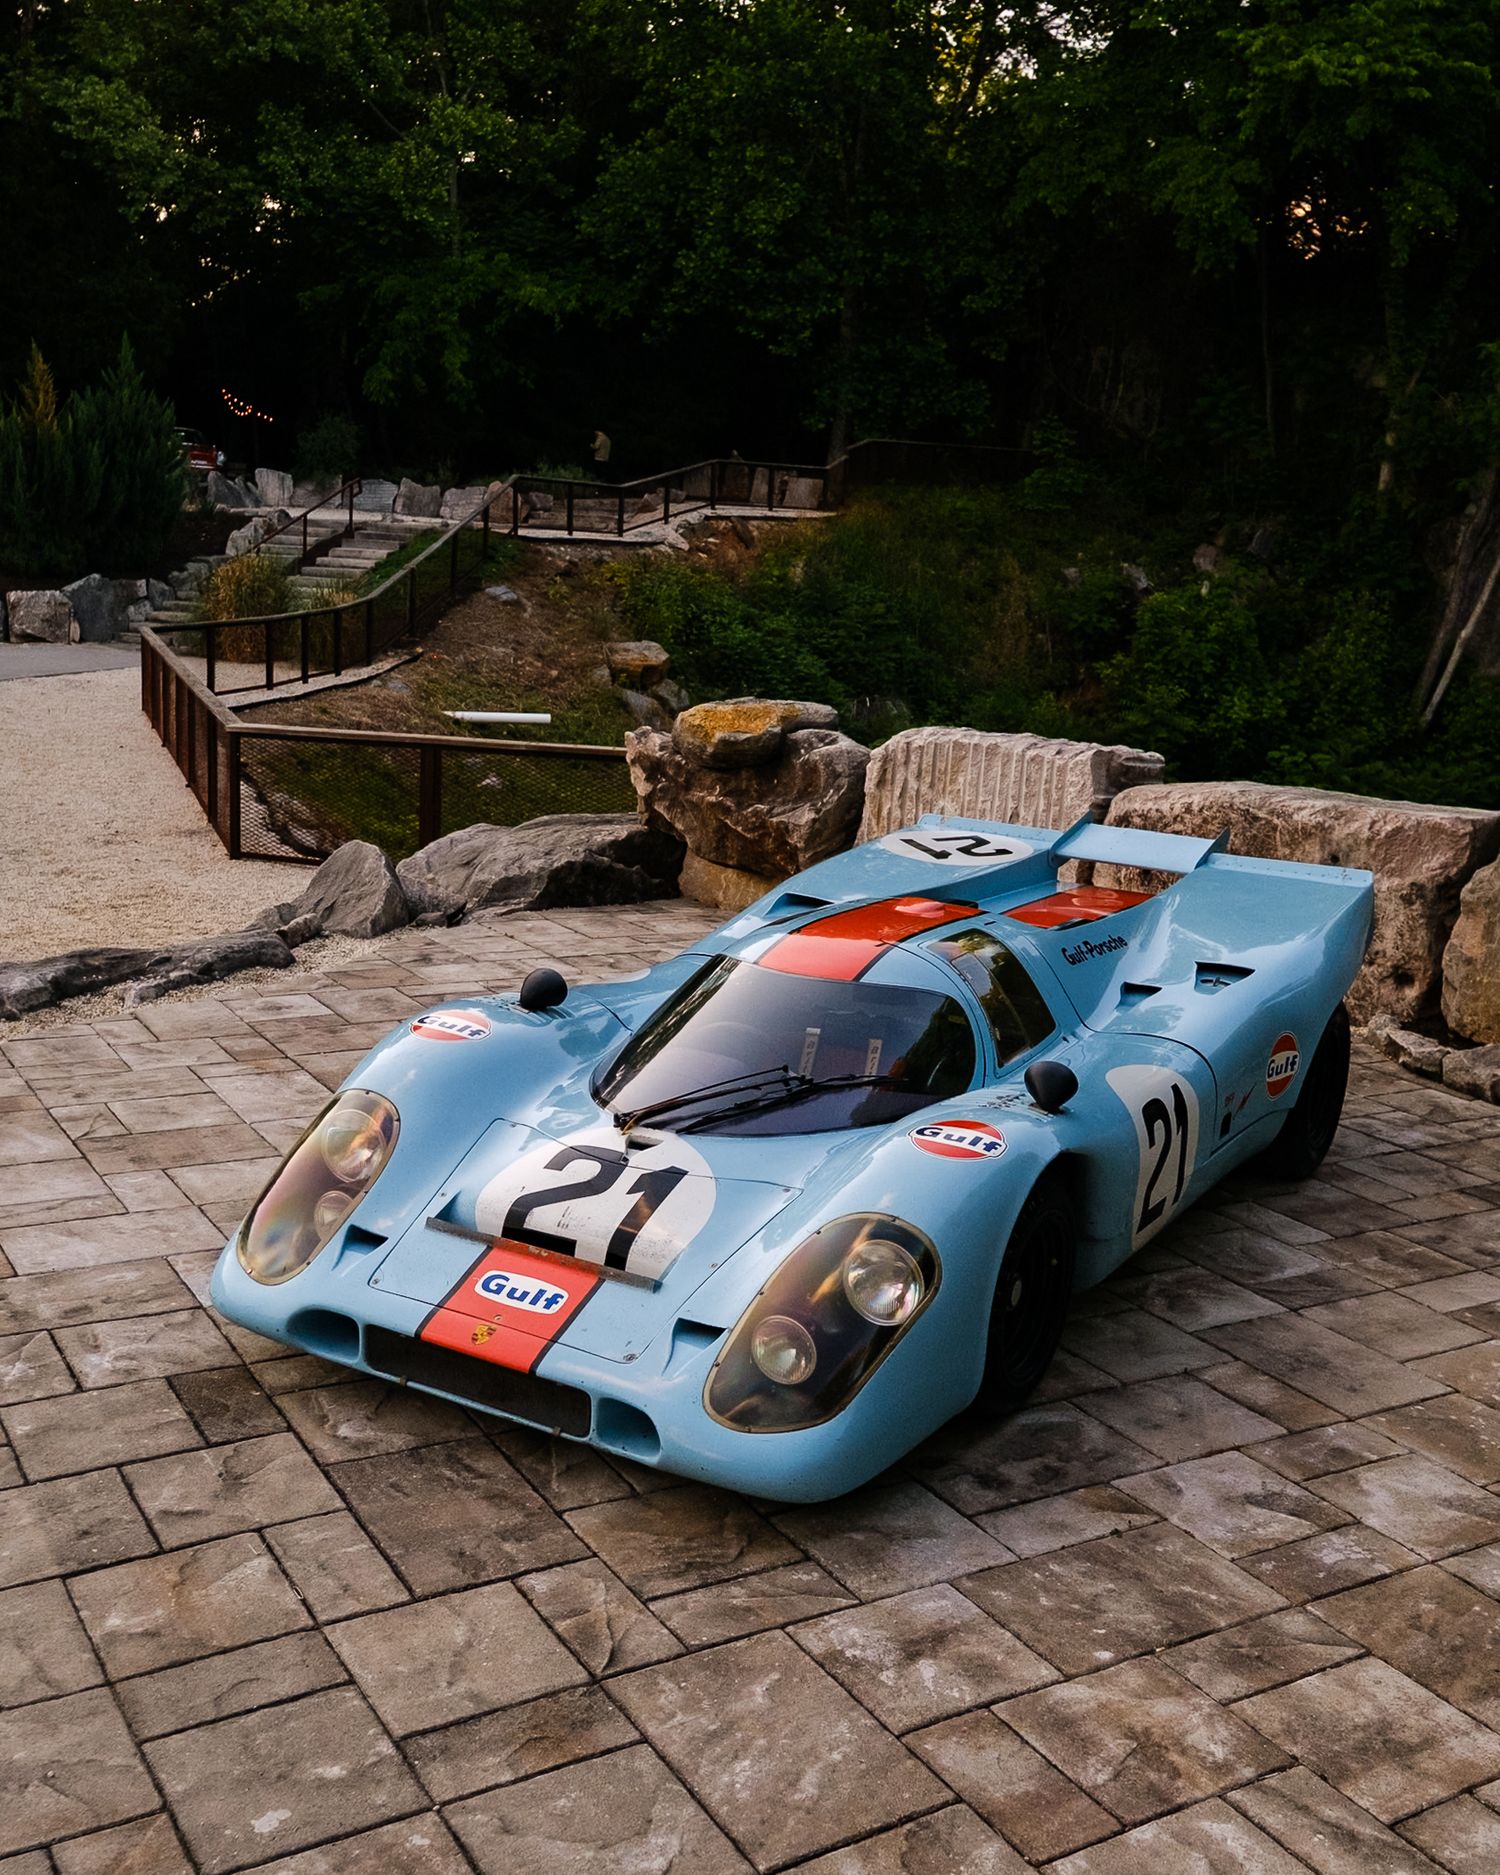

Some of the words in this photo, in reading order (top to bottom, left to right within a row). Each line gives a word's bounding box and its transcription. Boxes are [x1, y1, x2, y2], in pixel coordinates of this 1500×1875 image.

[900, 835, 1013, 860] 21
[1061, 934, 1128, 966] Gulf-Porsche
[417, 1015, 487, 1037] Gulf
[1267, 1054, 1299, 1079] Gulf
[915, 1126, 1002, 1153] Gulf
[1136, 1082, 1188, 1235] 21
[502, 1144, 690, 1272] 21
[481, 1274, 565, 1310] Gulf
